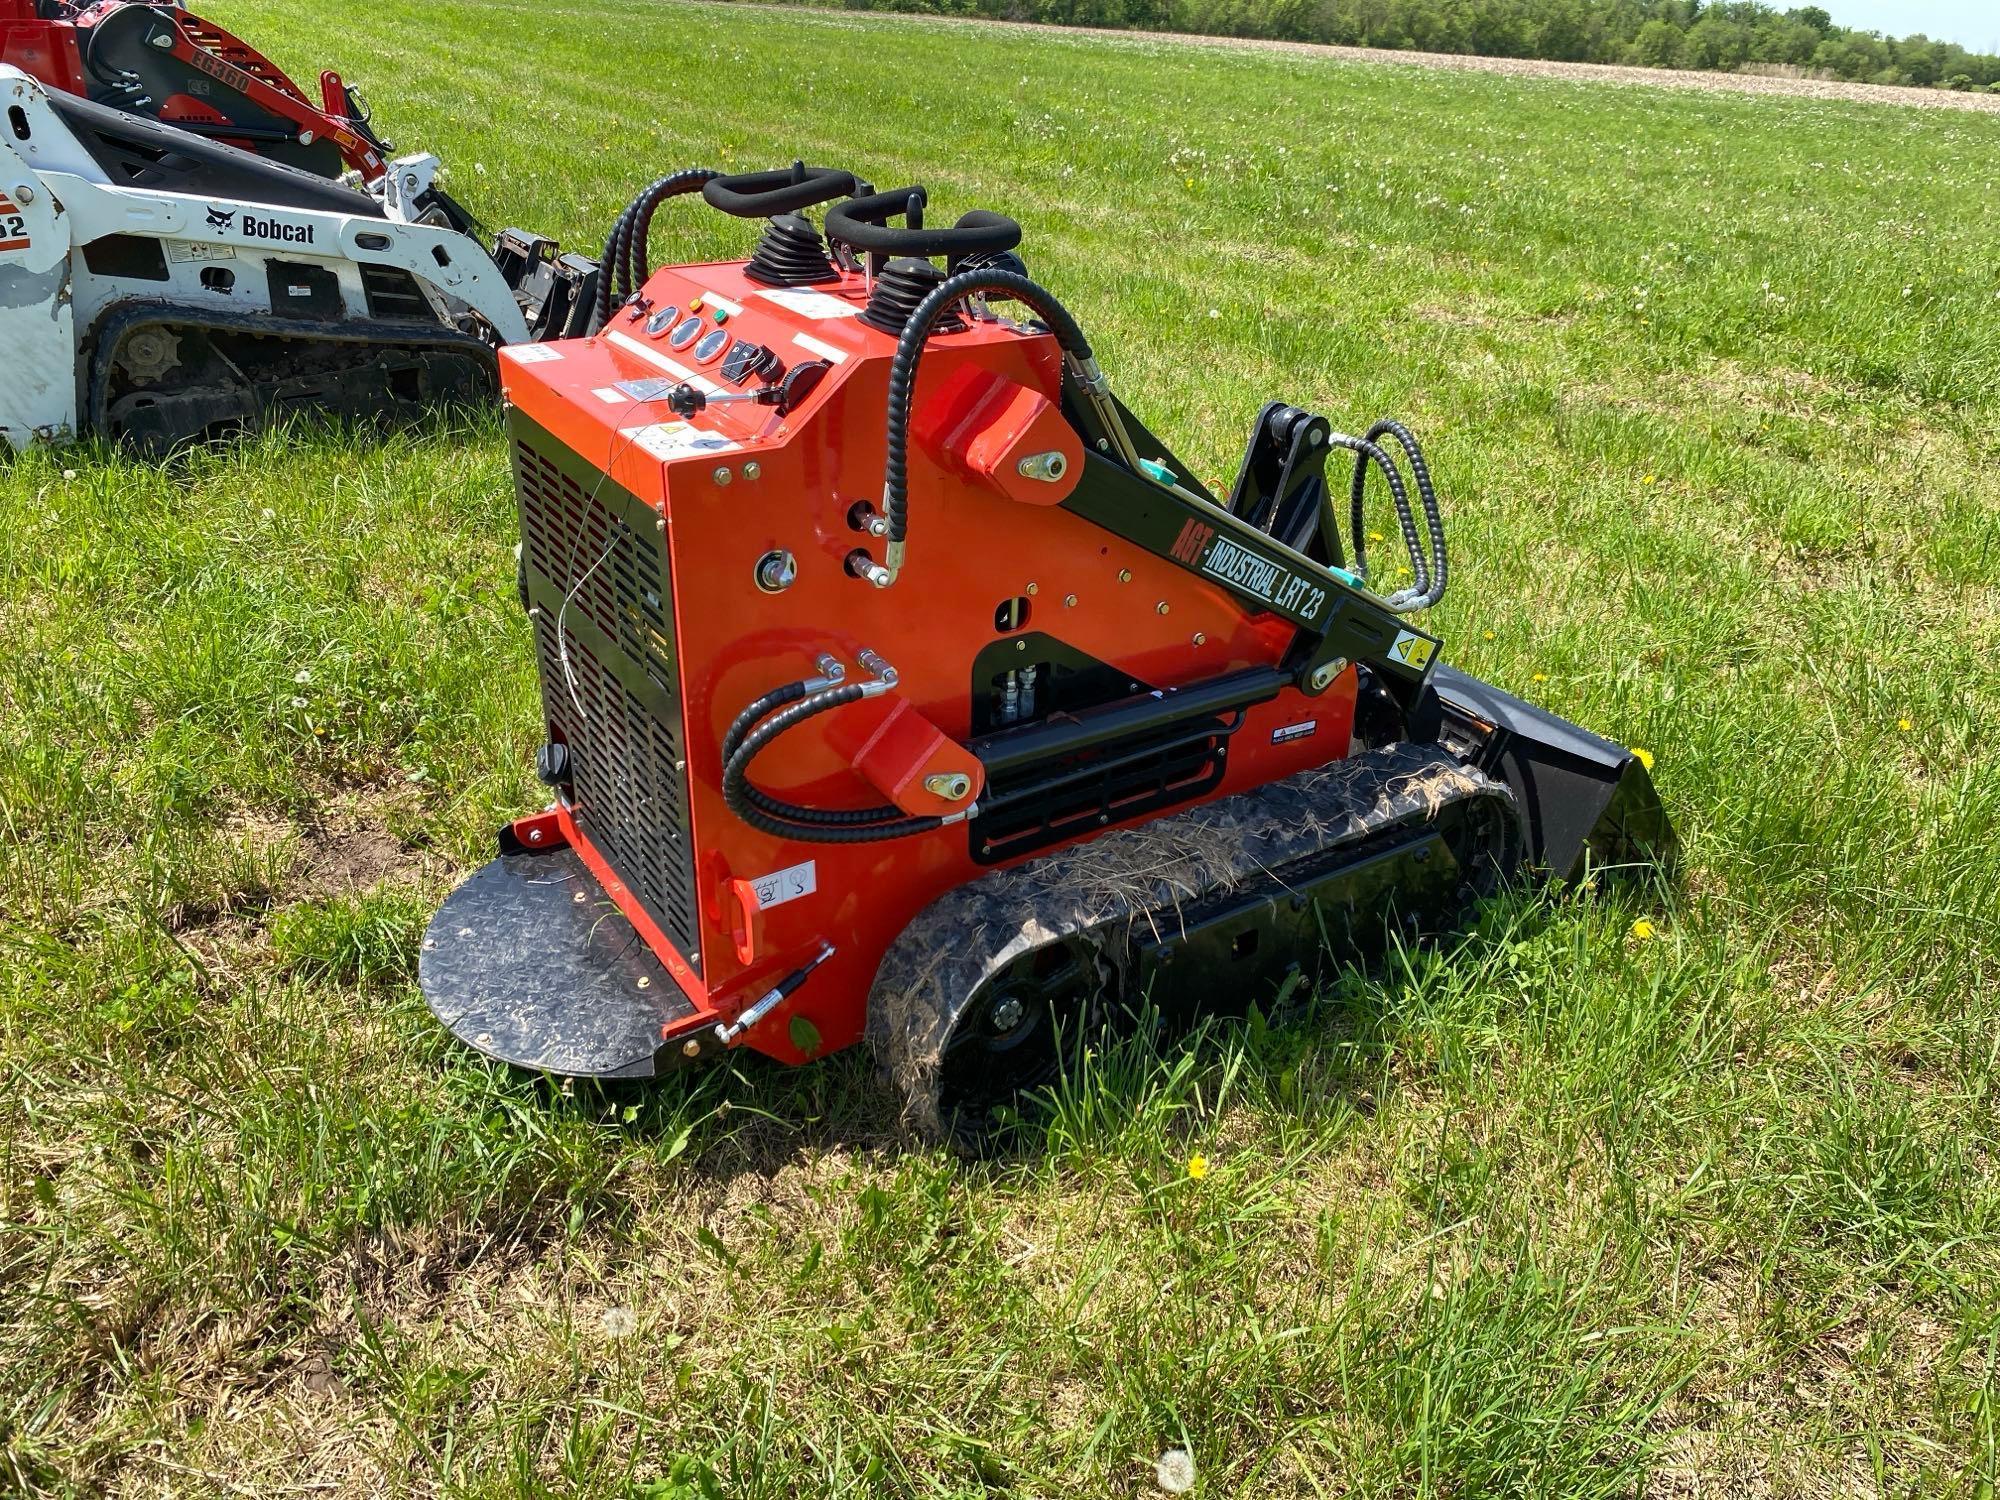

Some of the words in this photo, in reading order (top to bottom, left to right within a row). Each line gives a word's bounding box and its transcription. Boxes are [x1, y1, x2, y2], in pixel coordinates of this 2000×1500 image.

[191, 50, 249, 93] EG360
[243, 215, 314, 244] Bobcat
[1170, 518, 1214, 566] AGT
[1300, 587, 1325, 620] 23
